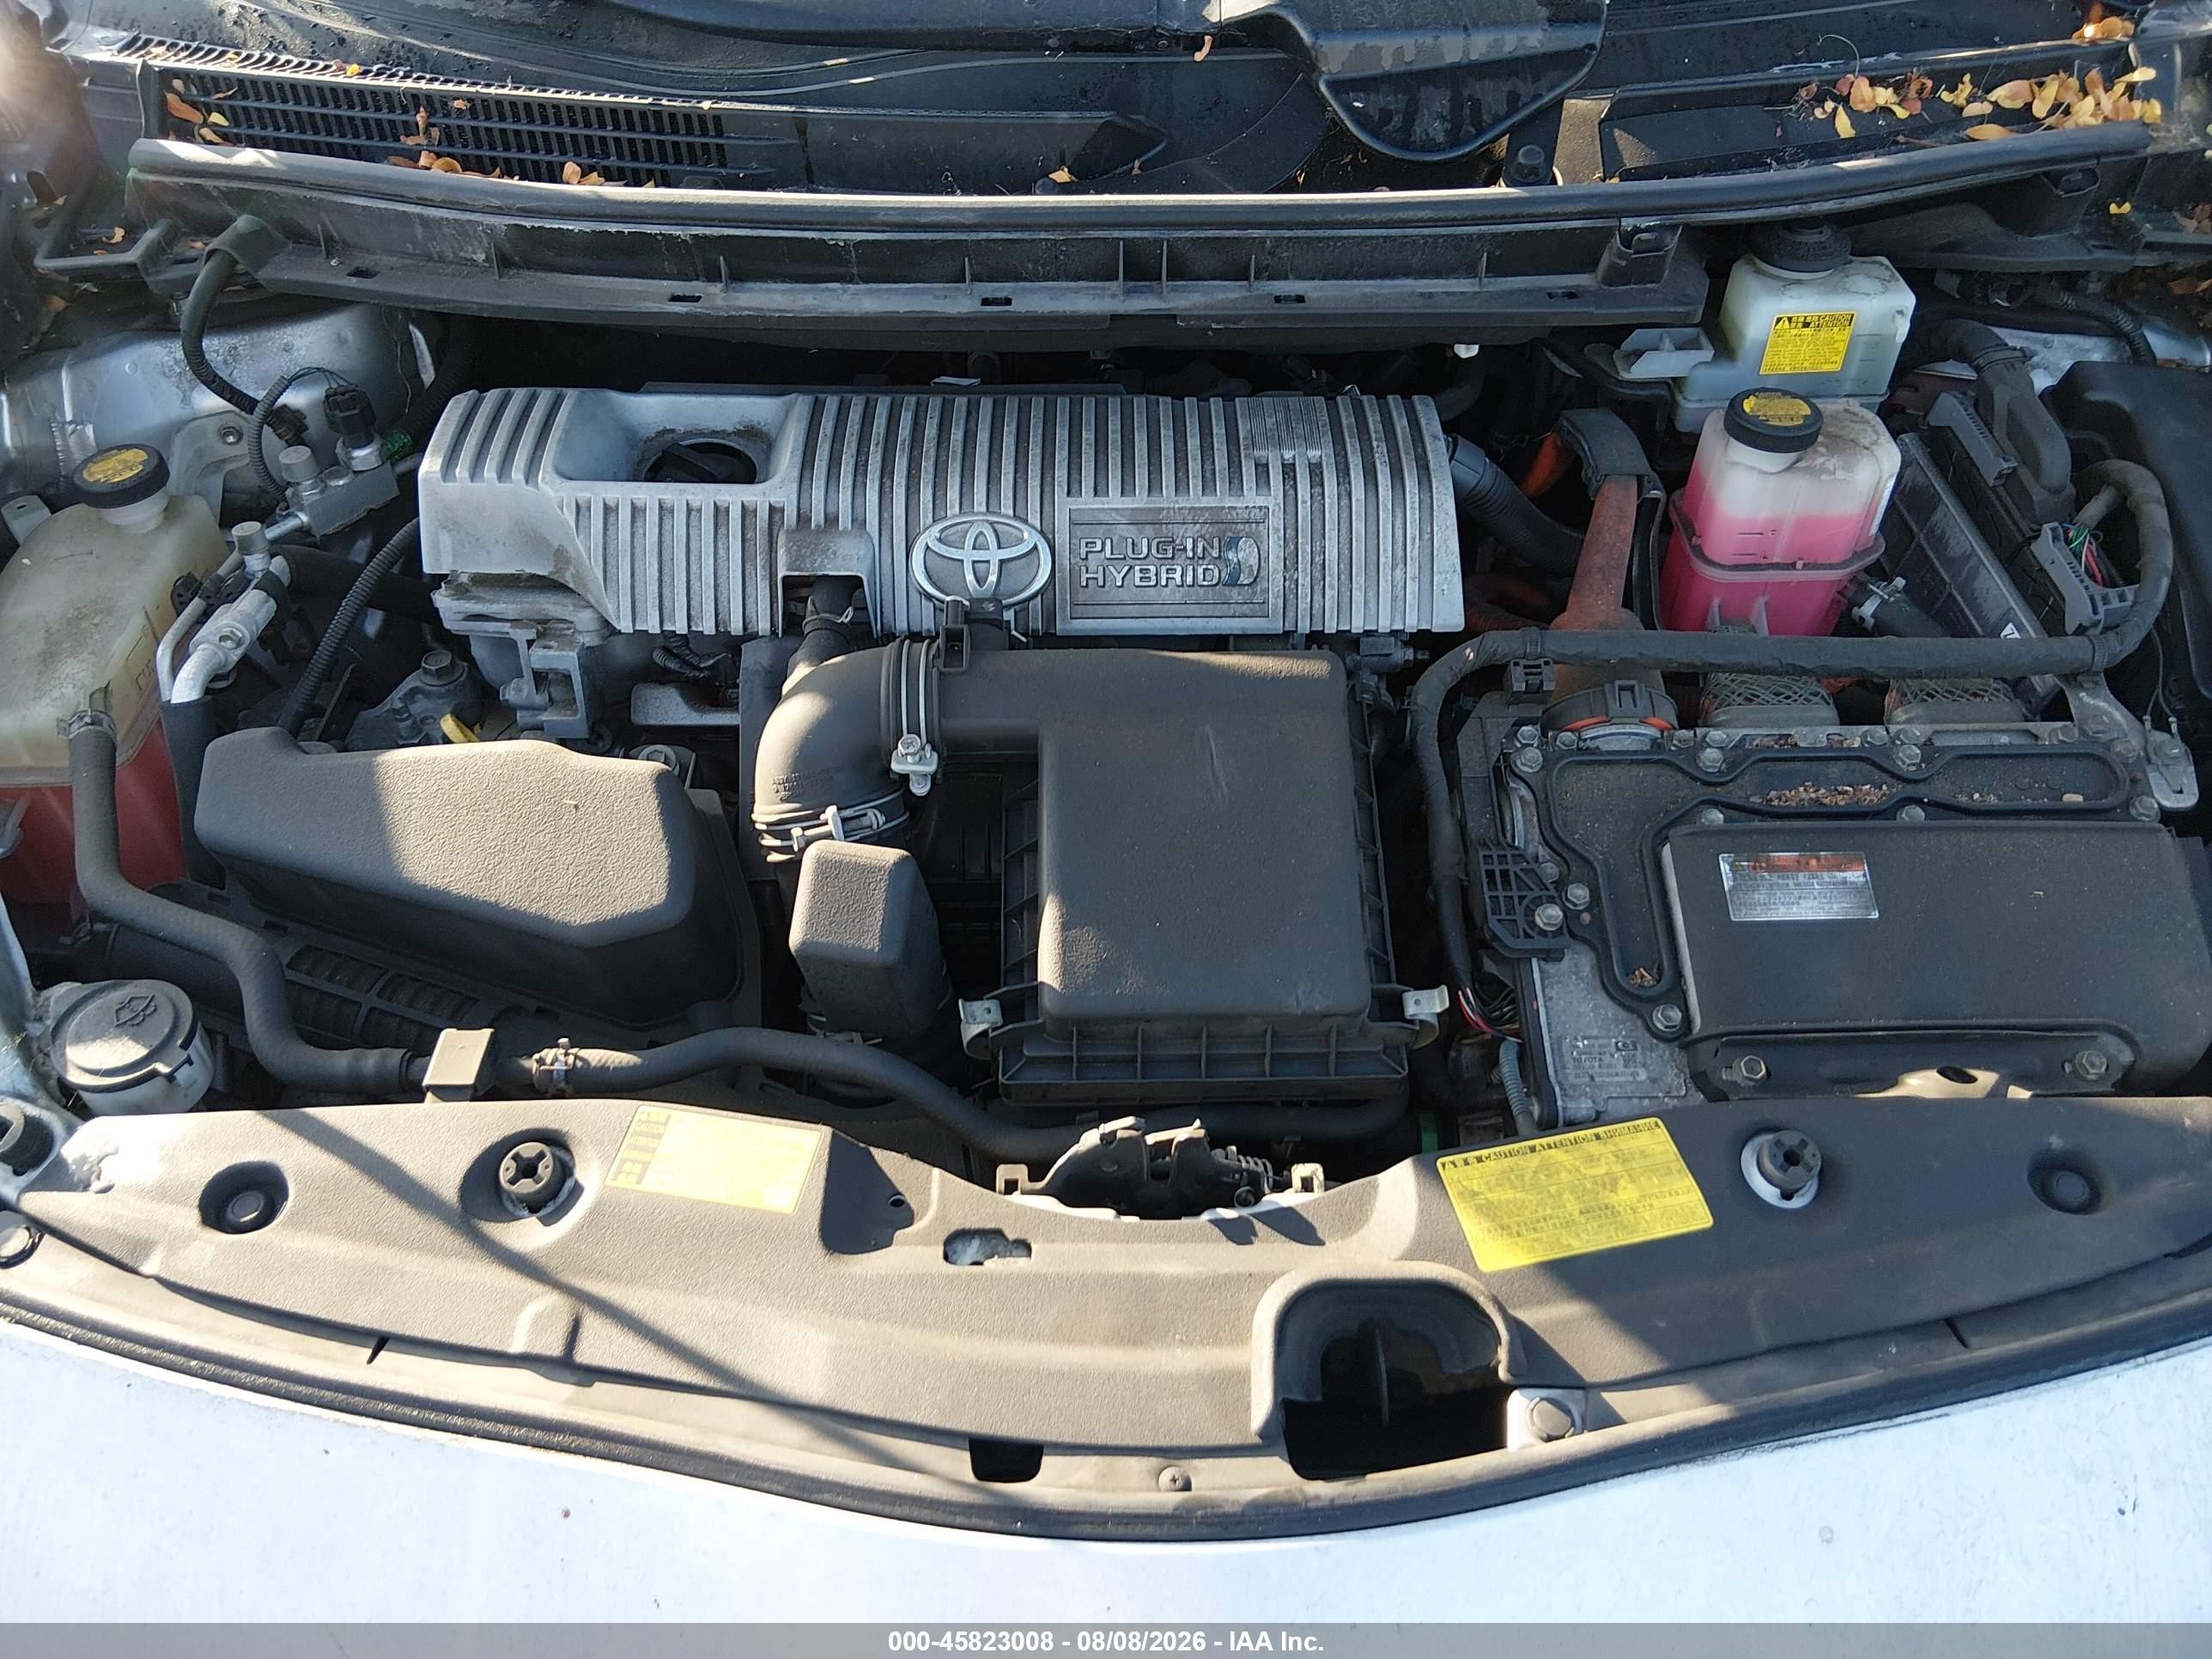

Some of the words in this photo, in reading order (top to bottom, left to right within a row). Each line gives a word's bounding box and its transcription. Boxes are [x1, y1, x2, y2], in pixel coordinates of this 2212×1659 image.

[1820, 313, 1851, 322] CAUTION
[1079, 537, 1221, 560] PLUG-IN
[1079, 564, 1221, 587] HYBRID
[1601, 1121, 1658, 1139] ВНИМАНИЕ
[1482, 1146, 1530, 1162] CAUTION
[1535, 1133, 1595, 1152] ATTENTION
